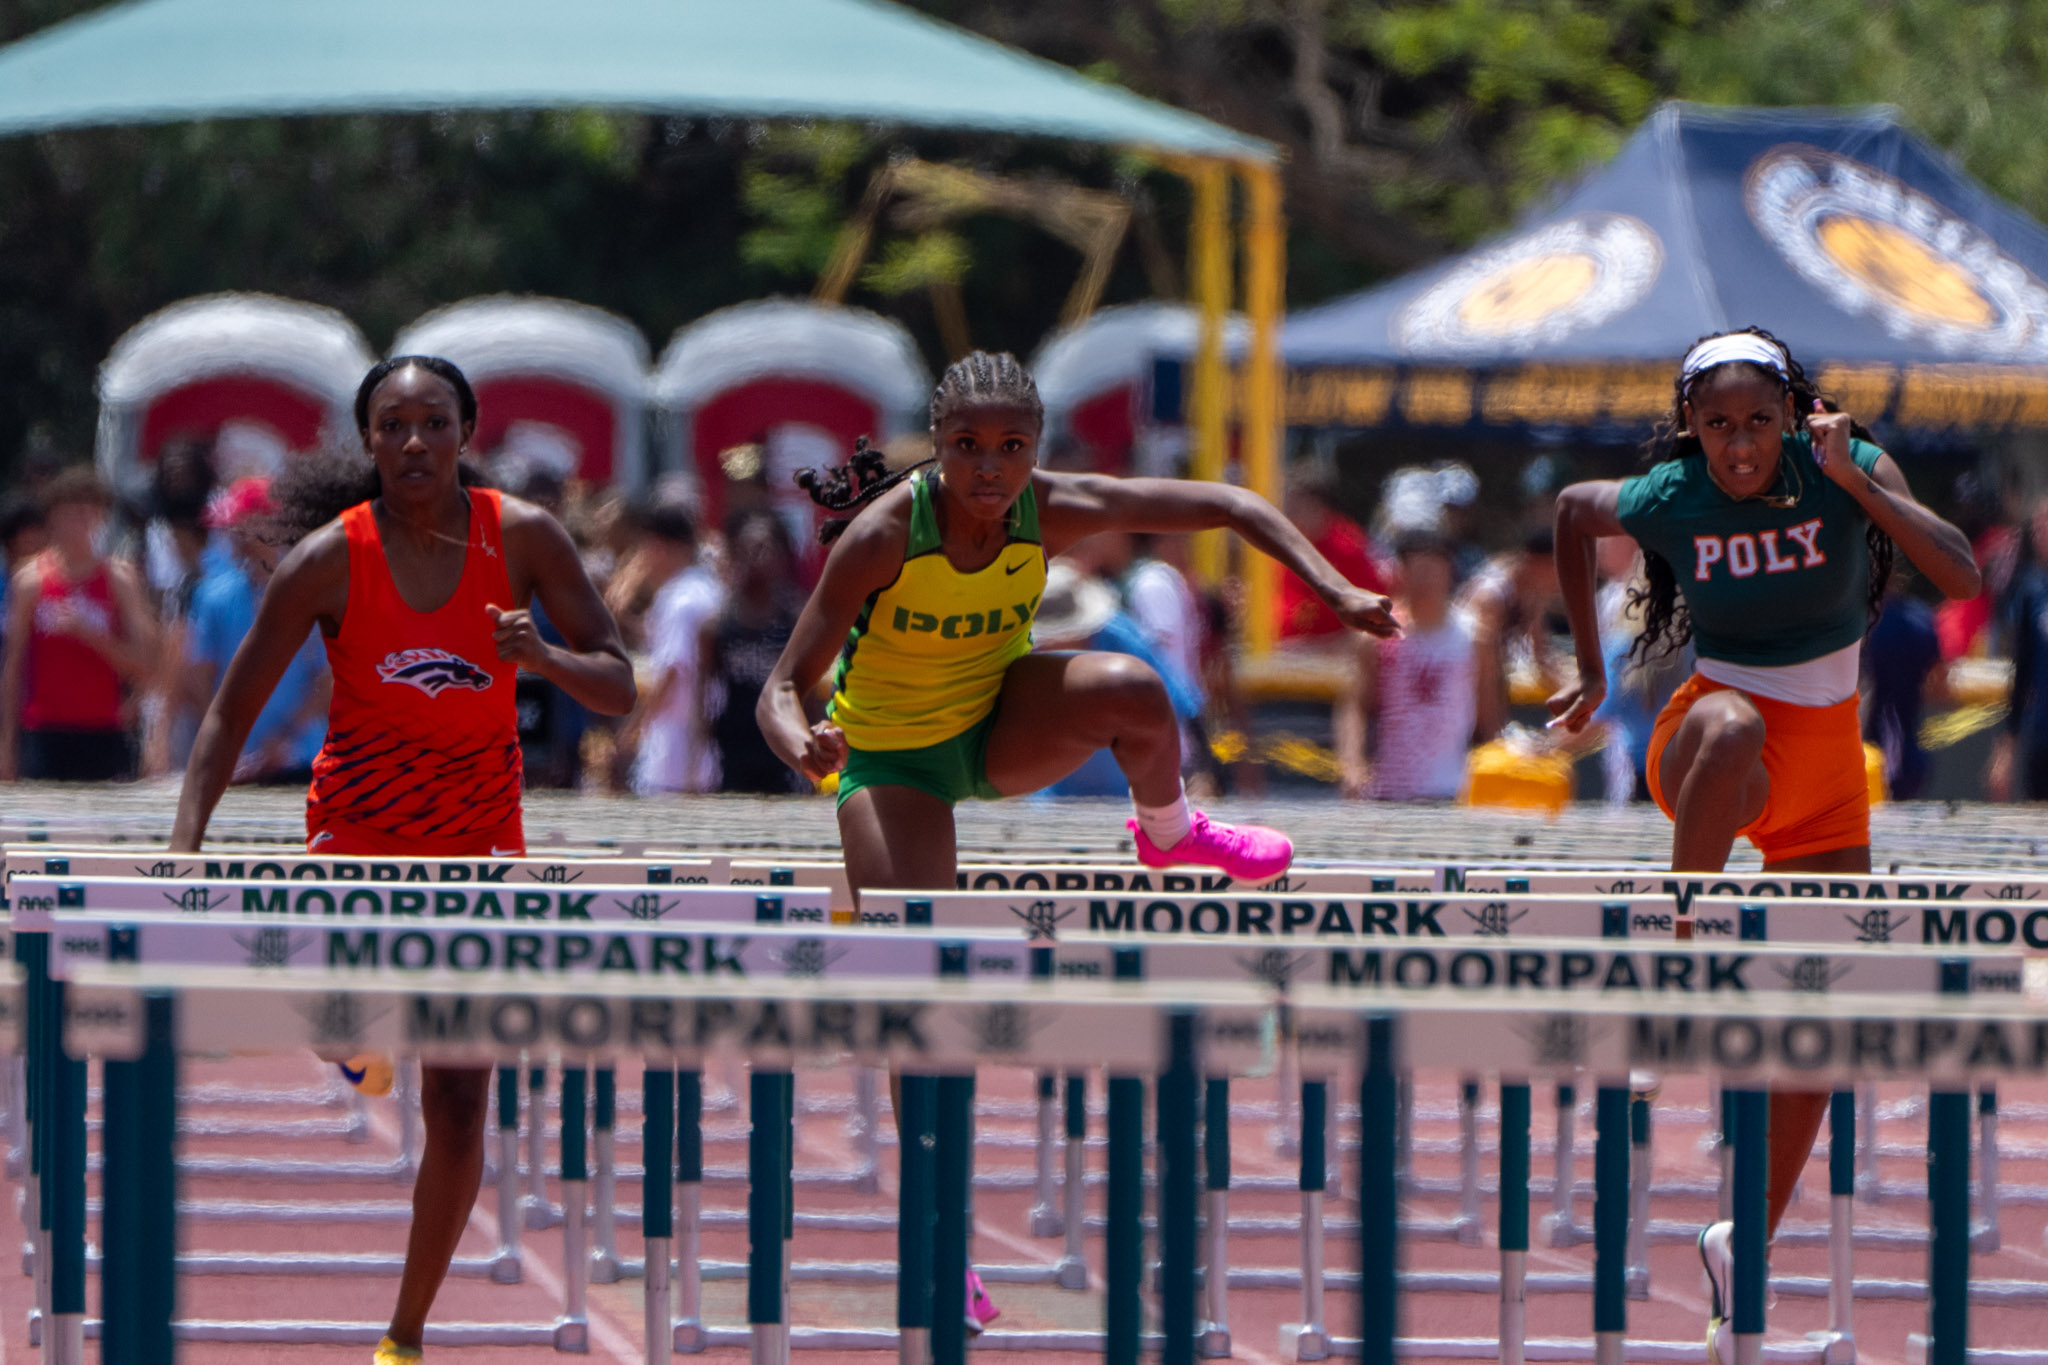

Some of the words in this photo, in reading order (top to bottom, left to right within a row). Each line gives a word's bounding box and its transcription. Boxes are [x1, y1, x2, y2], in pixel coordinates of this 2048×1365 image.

[1693, 516, 1826, 582] POLY
[242, 888, 601, 920] MOORPARK
[955, 871, 1232, 893] OORPARK
[1088, 900, 1445, 937] MOORPARK
[328, 932, 751, 976] MOORPARK
[1328, 949, 1750, 993] MOORPARK
[408, 993, 929, 1050] MOORPARK
